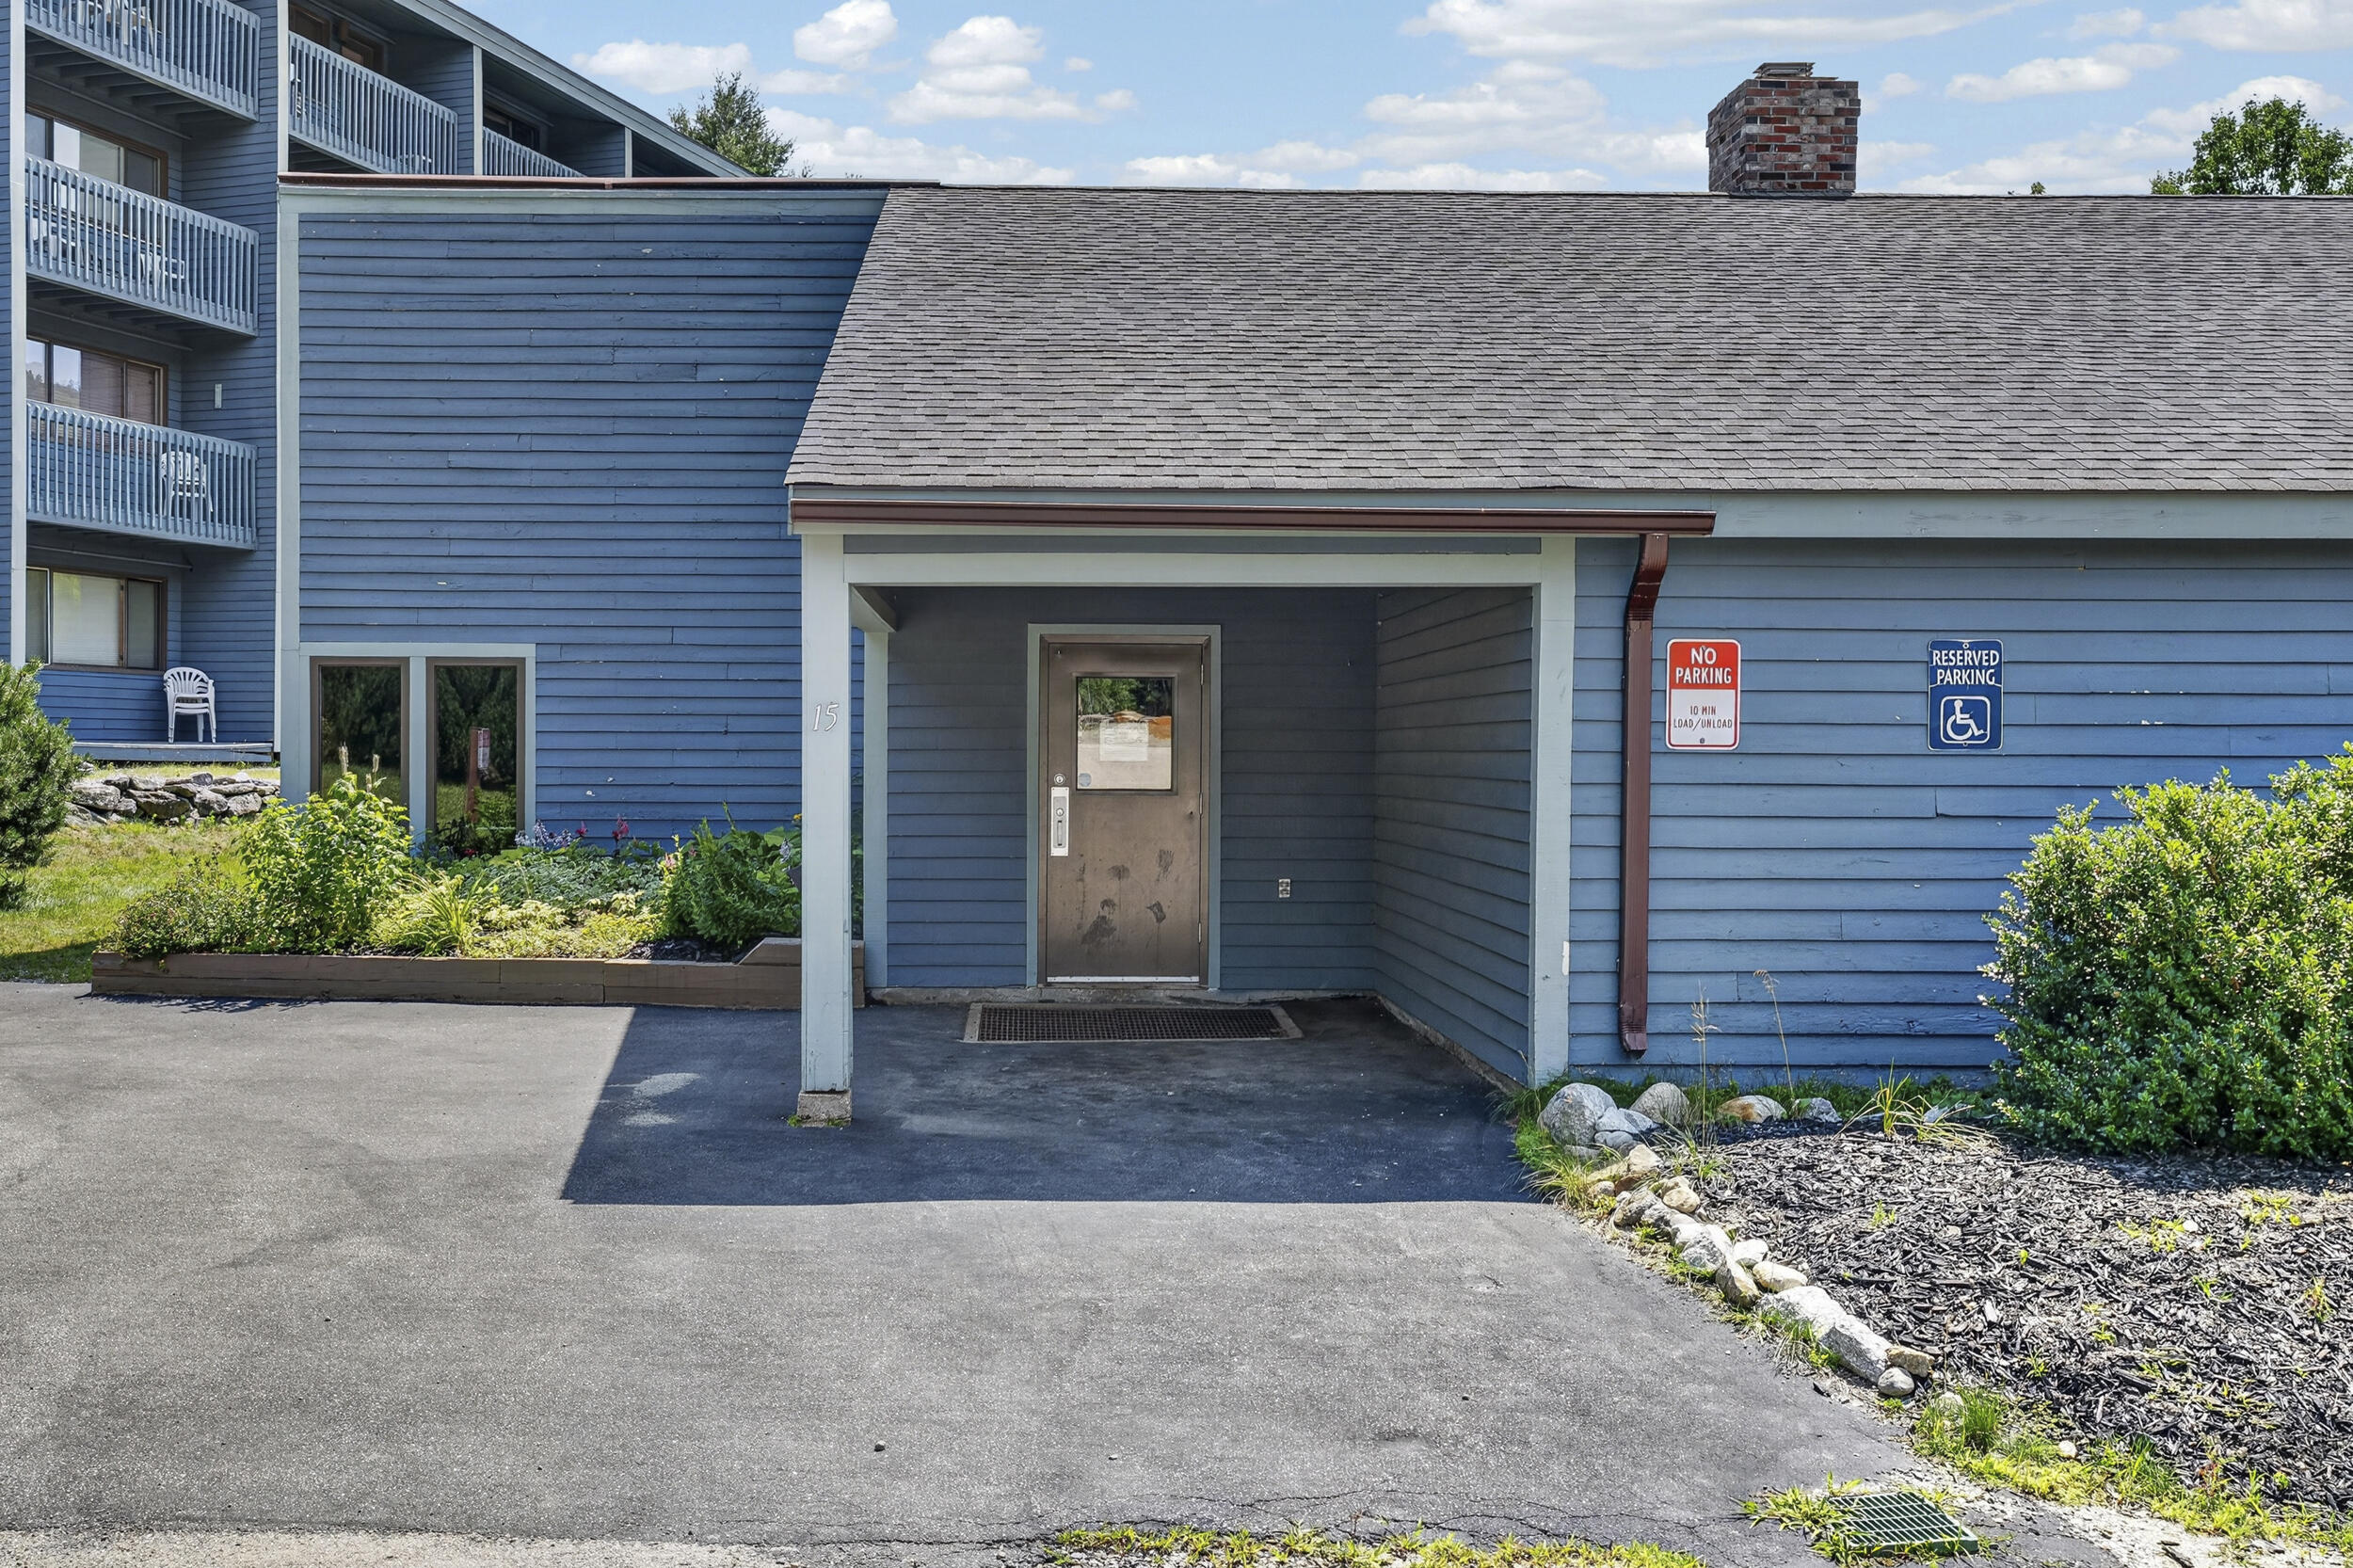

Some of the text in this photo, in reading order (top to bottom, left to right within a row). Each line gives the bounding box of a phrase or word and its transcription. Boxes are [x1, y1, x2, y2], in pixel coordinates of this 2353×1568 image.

[1690, 647, 1717, 664] NO
[1932, 649, 2000, 666] RESERVED
[1675, 666, 1732, 684] PARKING
[1937, 668, 1995, 685] PARKING
[812, 703, 840, 731] 15
[1690, 705, 1717, 716] 10 MIN
[1673, 717, 1733, 731] LOAD/UNLOAD
